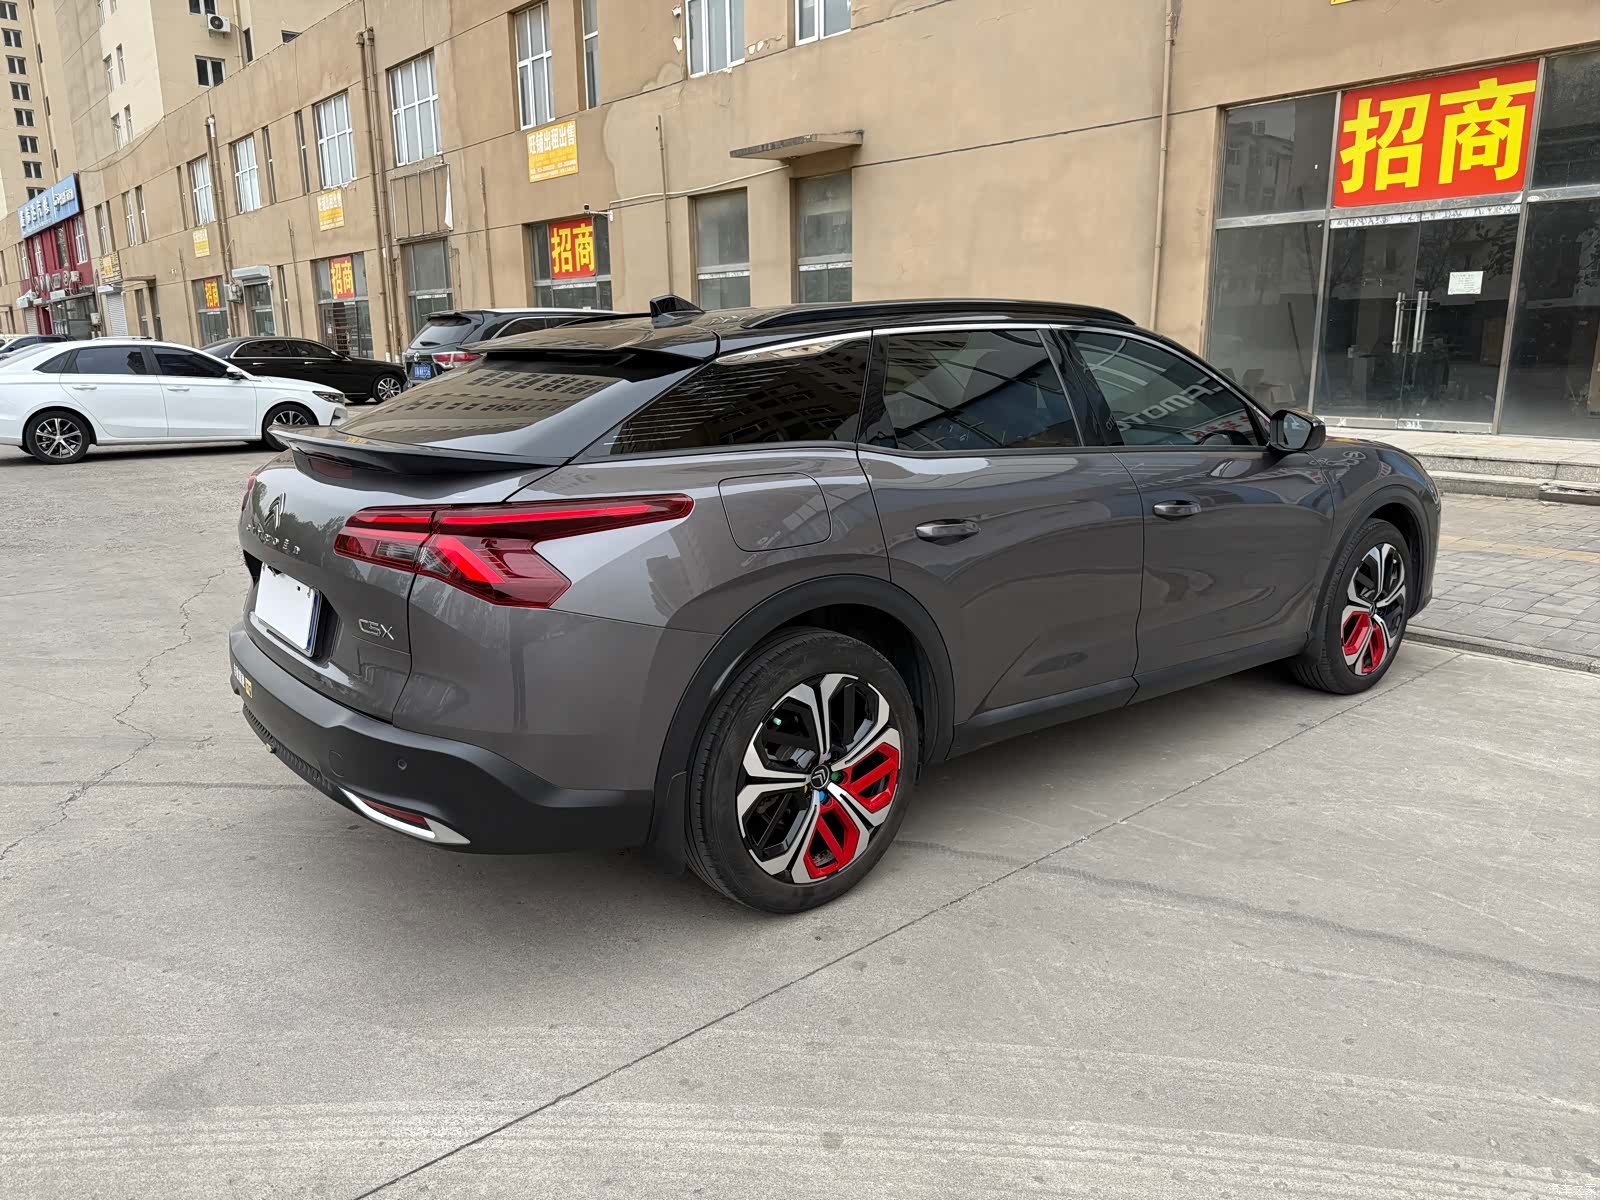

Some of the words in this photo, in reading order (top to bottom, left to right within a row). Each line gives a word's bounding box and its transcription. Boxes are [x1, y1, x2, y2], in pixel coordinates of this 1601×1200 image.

[1340, 77, 1537, 194] 招商
[551, 223, 595, 273] 招商
[330, 260, 354, 297] 招商
[358, 618, 394, 640] C5X
